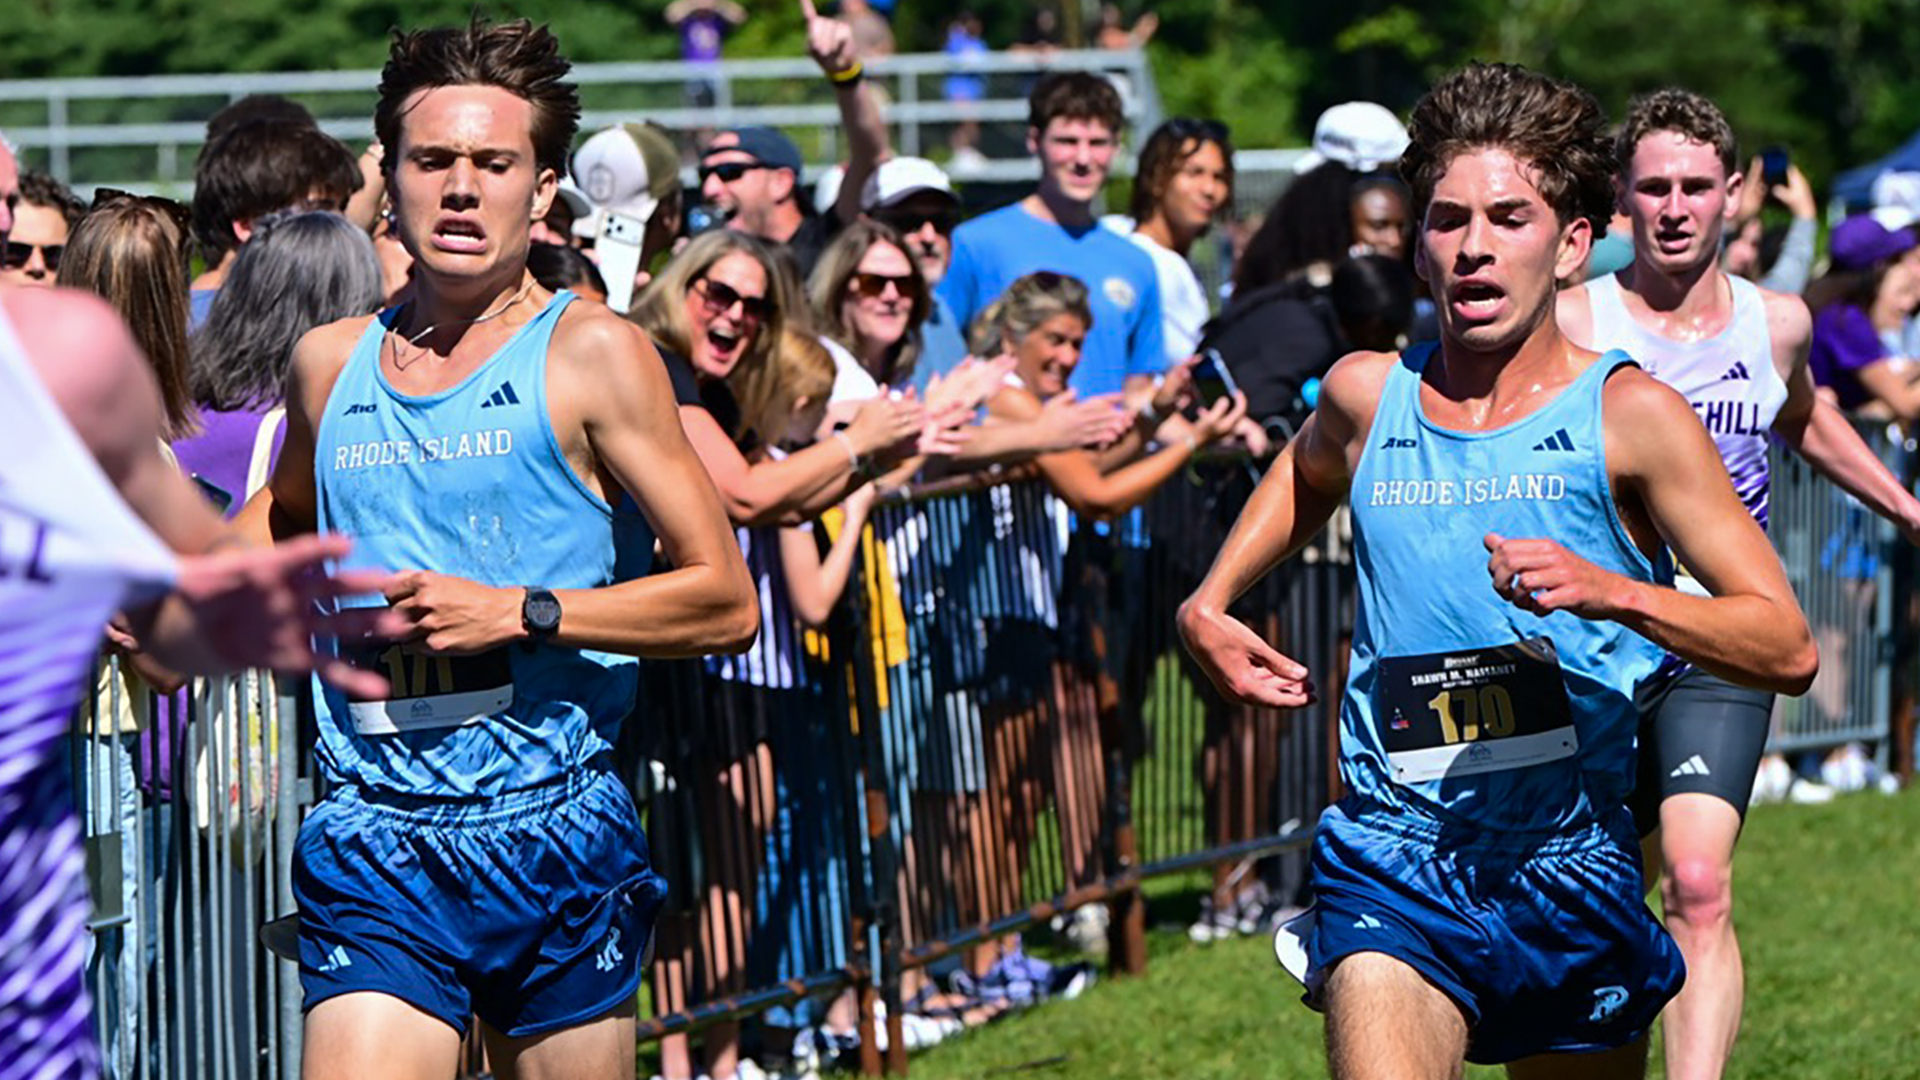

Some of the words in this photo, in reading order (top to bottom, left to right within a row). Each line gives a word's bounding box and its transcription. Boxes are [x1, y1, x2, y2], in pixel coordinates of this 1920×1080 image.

[1692, 401, 1762, 436] HILL
[334, 440, 411, 471] RHODE
[418, 429, 513, 464] ISLAND
[1370, 480, 1454, 506] RHODE
[1464, 474, 1566, 505] ISLAND
[1428, 684, 1516, 744] 170
